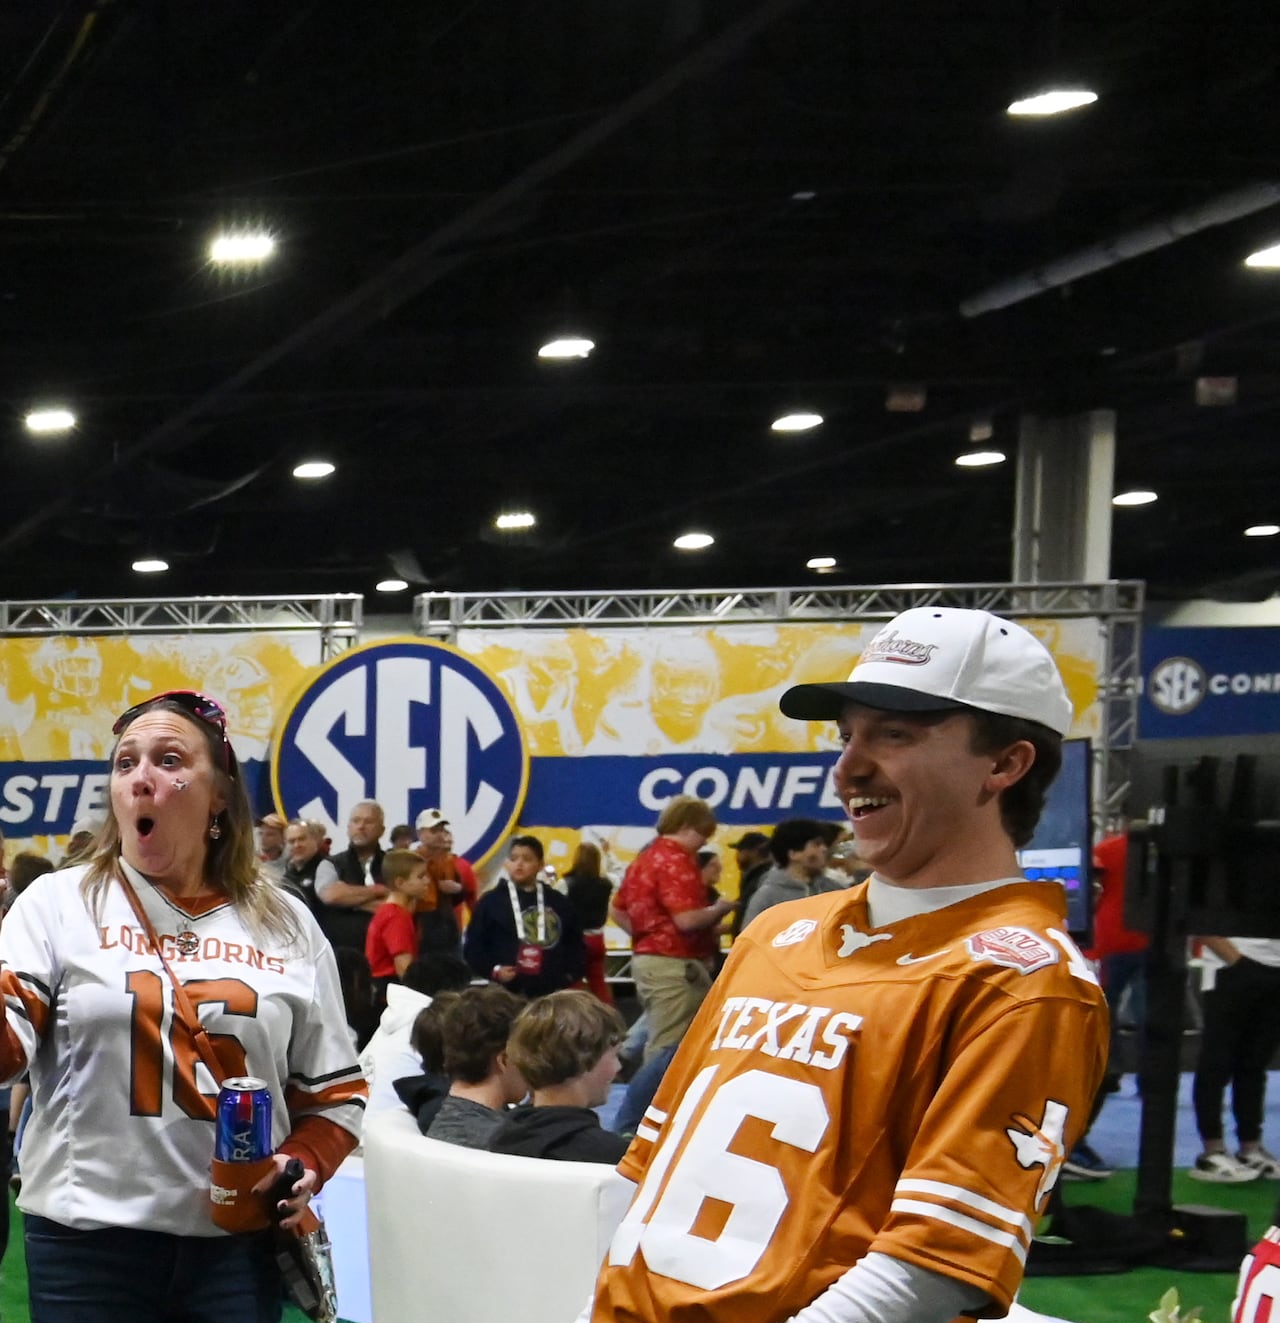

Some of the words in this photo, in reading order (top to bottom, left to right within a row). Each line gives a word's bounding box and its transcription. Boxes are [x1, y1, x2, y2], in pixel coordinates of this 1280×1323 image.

[293, 656, 505, 862] SEC
[1151, 661, 1203, 710] SEC
[125, 969, 259, 1122] 16
[711, 996, 863, 1070] TEXAS
[608, 1065, 831, 1291] 16
